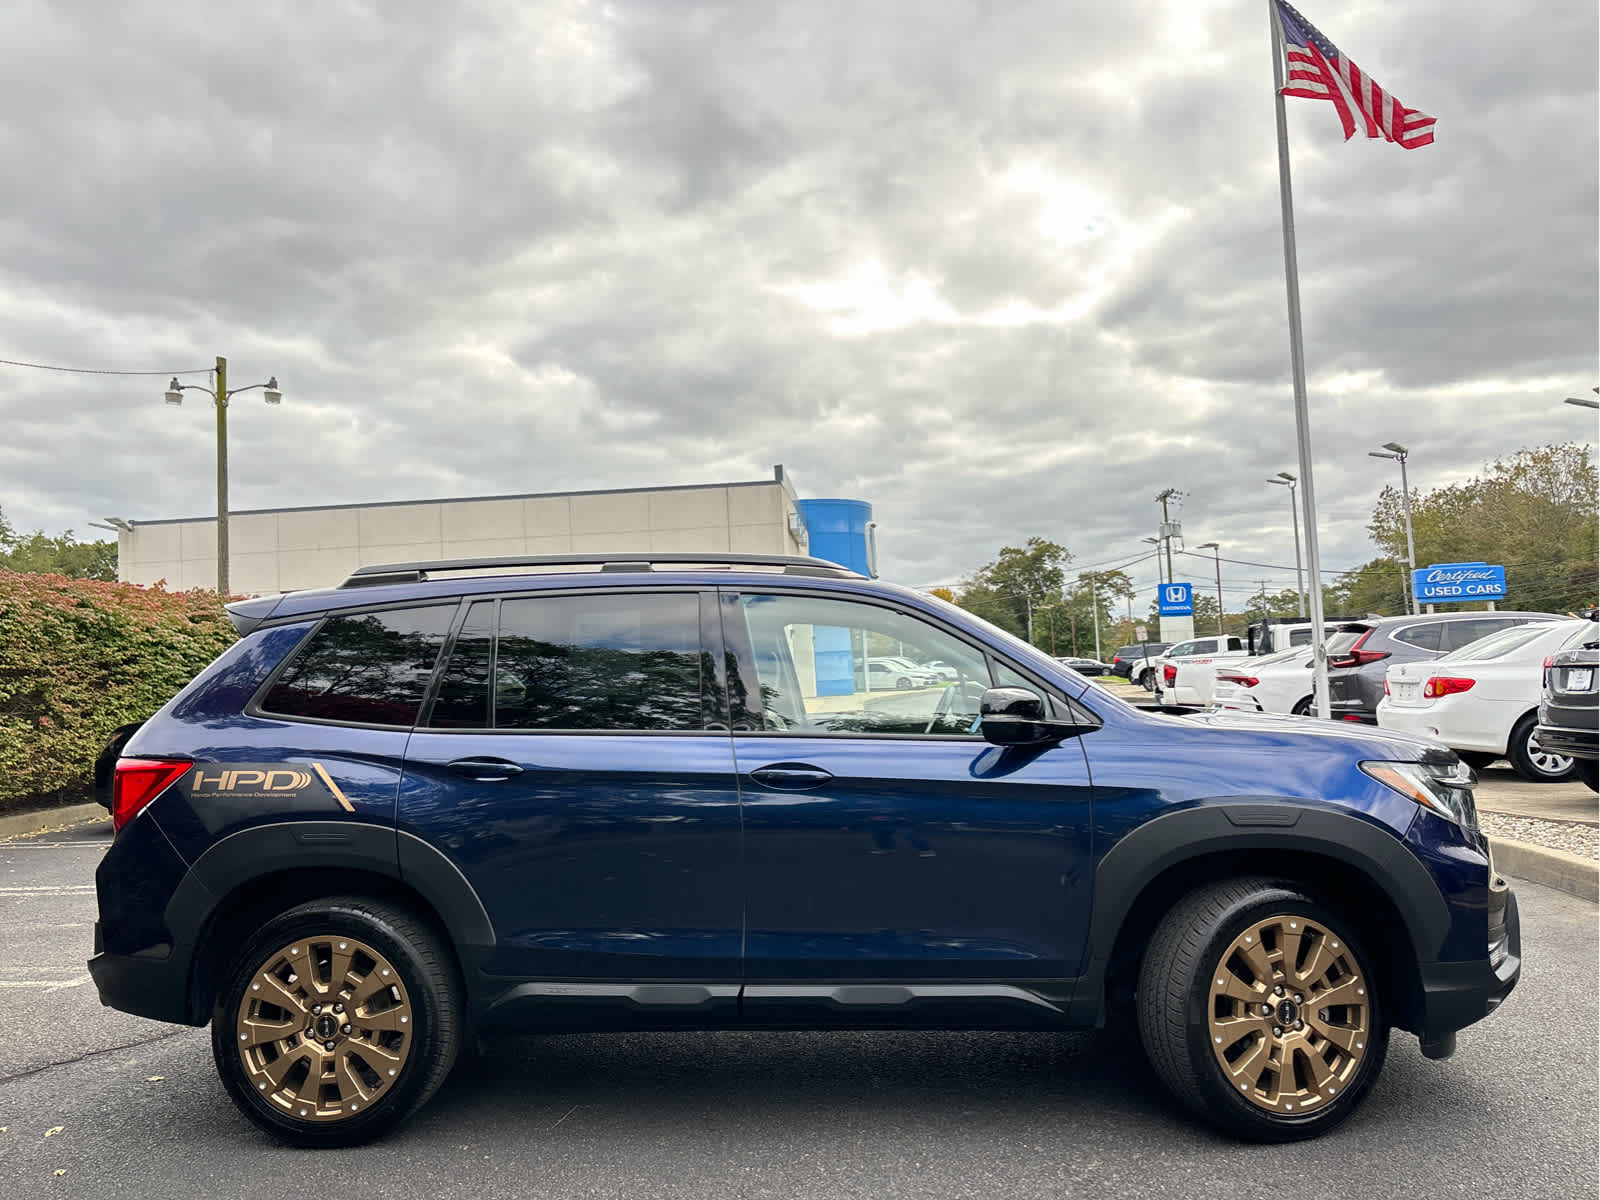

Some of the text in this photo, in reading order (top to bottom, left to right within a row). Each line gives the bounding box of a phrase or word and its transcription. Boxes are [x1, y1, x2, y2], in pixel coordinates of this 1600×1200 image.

[1427, 569, 1496, 584] Certified
[1424, 584, 1502, 596] USED CARS
[192, 770, 311, 791] HPD
